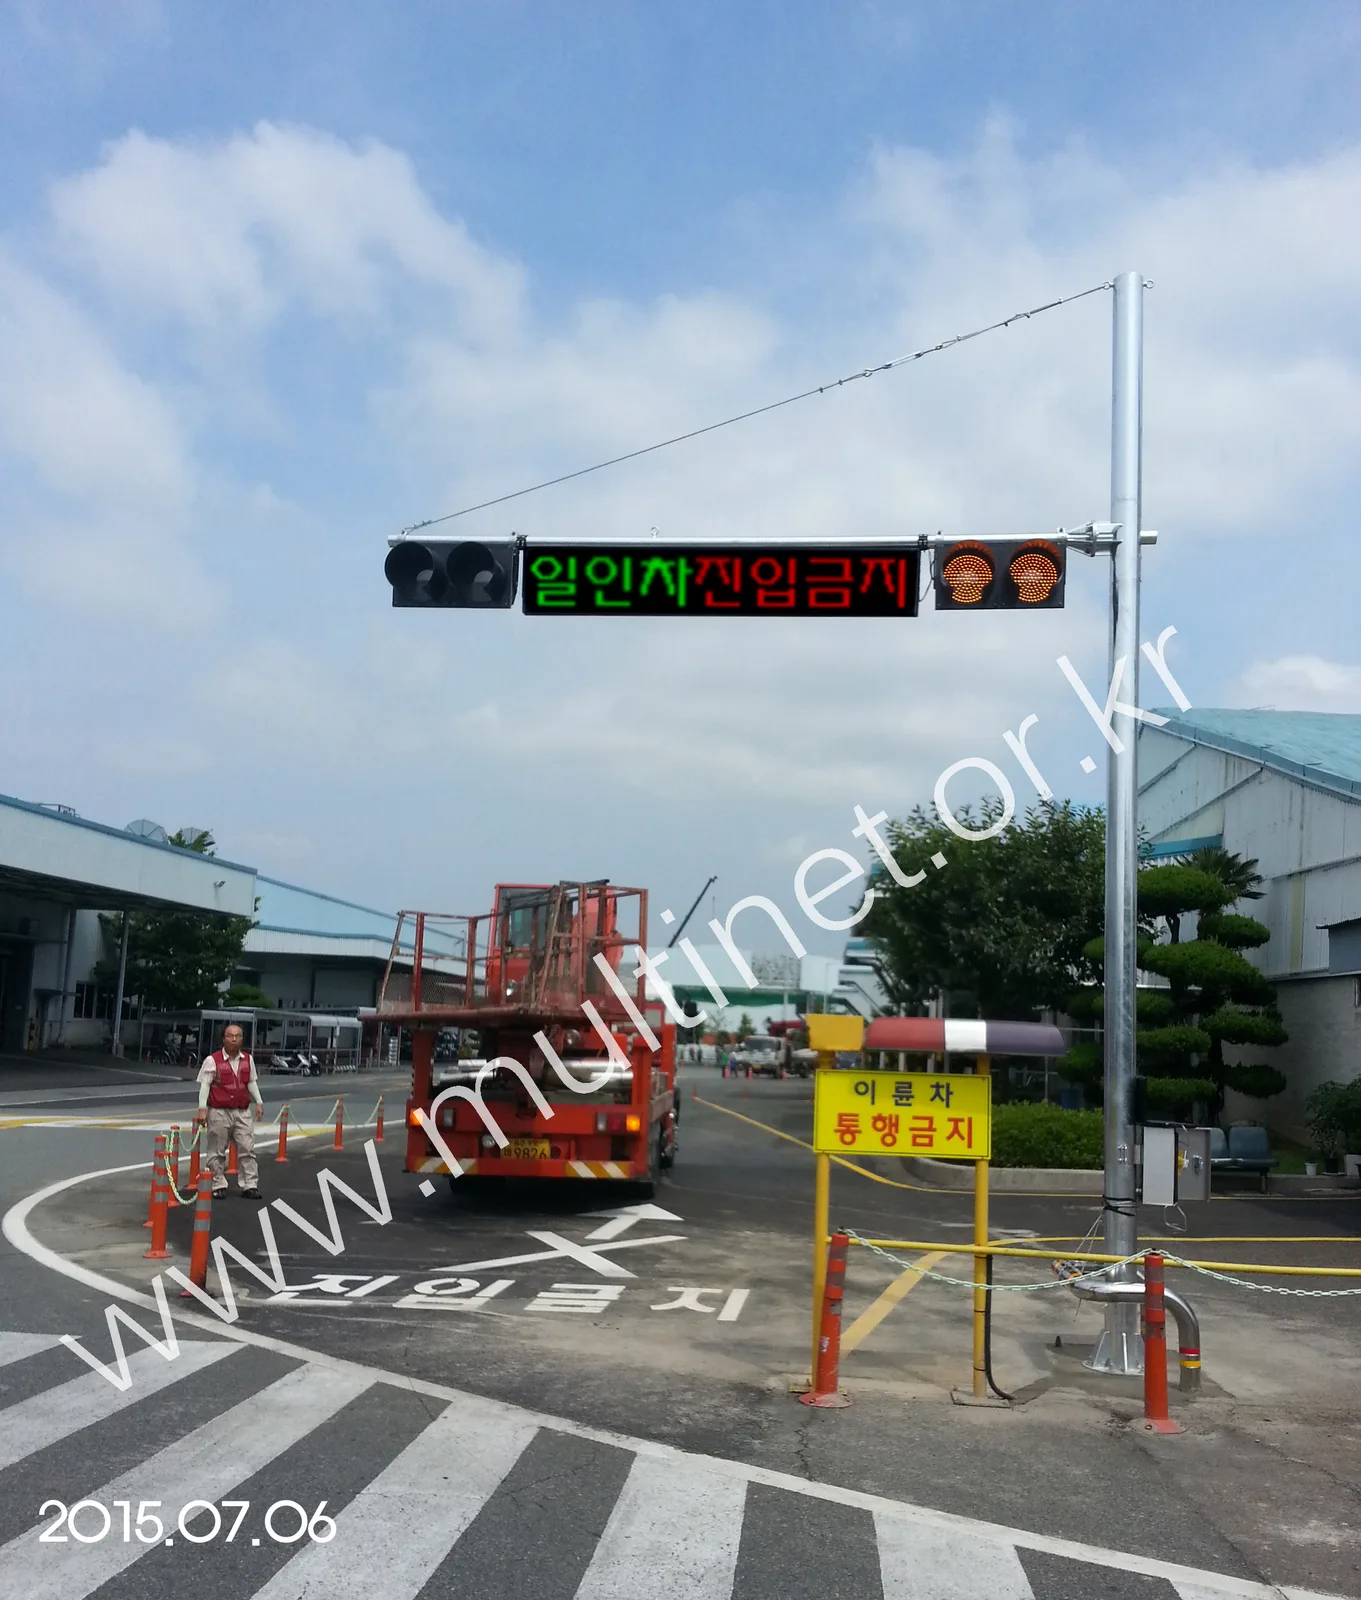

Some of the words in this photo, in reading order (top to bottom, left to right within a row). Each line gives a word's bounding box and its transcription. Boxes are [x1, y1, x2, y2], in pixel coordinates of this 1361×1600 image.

[694, 557, 907, 608] 진입금지
[854, 1079, 953, 1108] 이륜차
[834, 1112, 973, 1148] 통행금지
